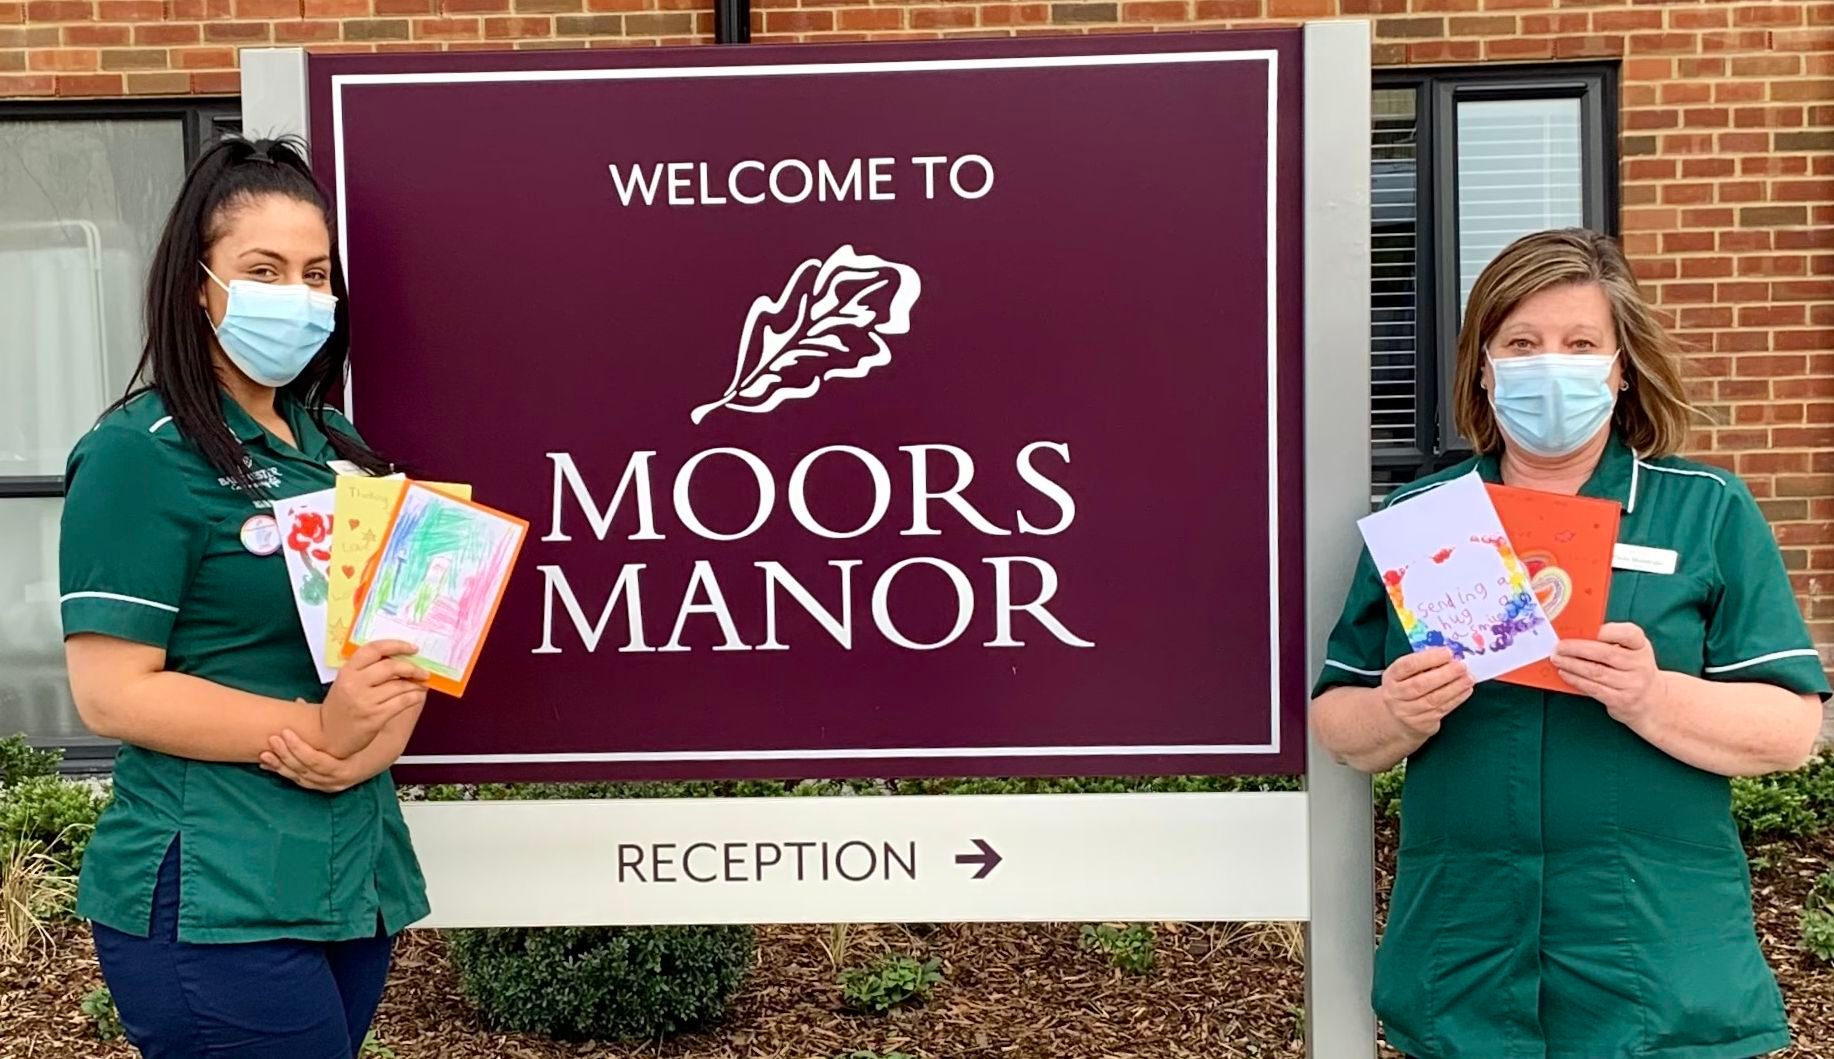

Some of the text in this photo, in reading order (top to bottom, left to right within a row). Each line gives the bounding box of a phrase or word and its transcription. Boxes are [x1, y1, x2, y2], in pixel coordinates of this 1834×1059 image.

[608, 154, 995, 207] WELCOME TO
[541, 440, 1076, 542] MOORS
[532, 555, 1096, 654] MANOR
[1437, 608, 1473, 630] hug
[617, 841, 916, 883] RECEPTION
